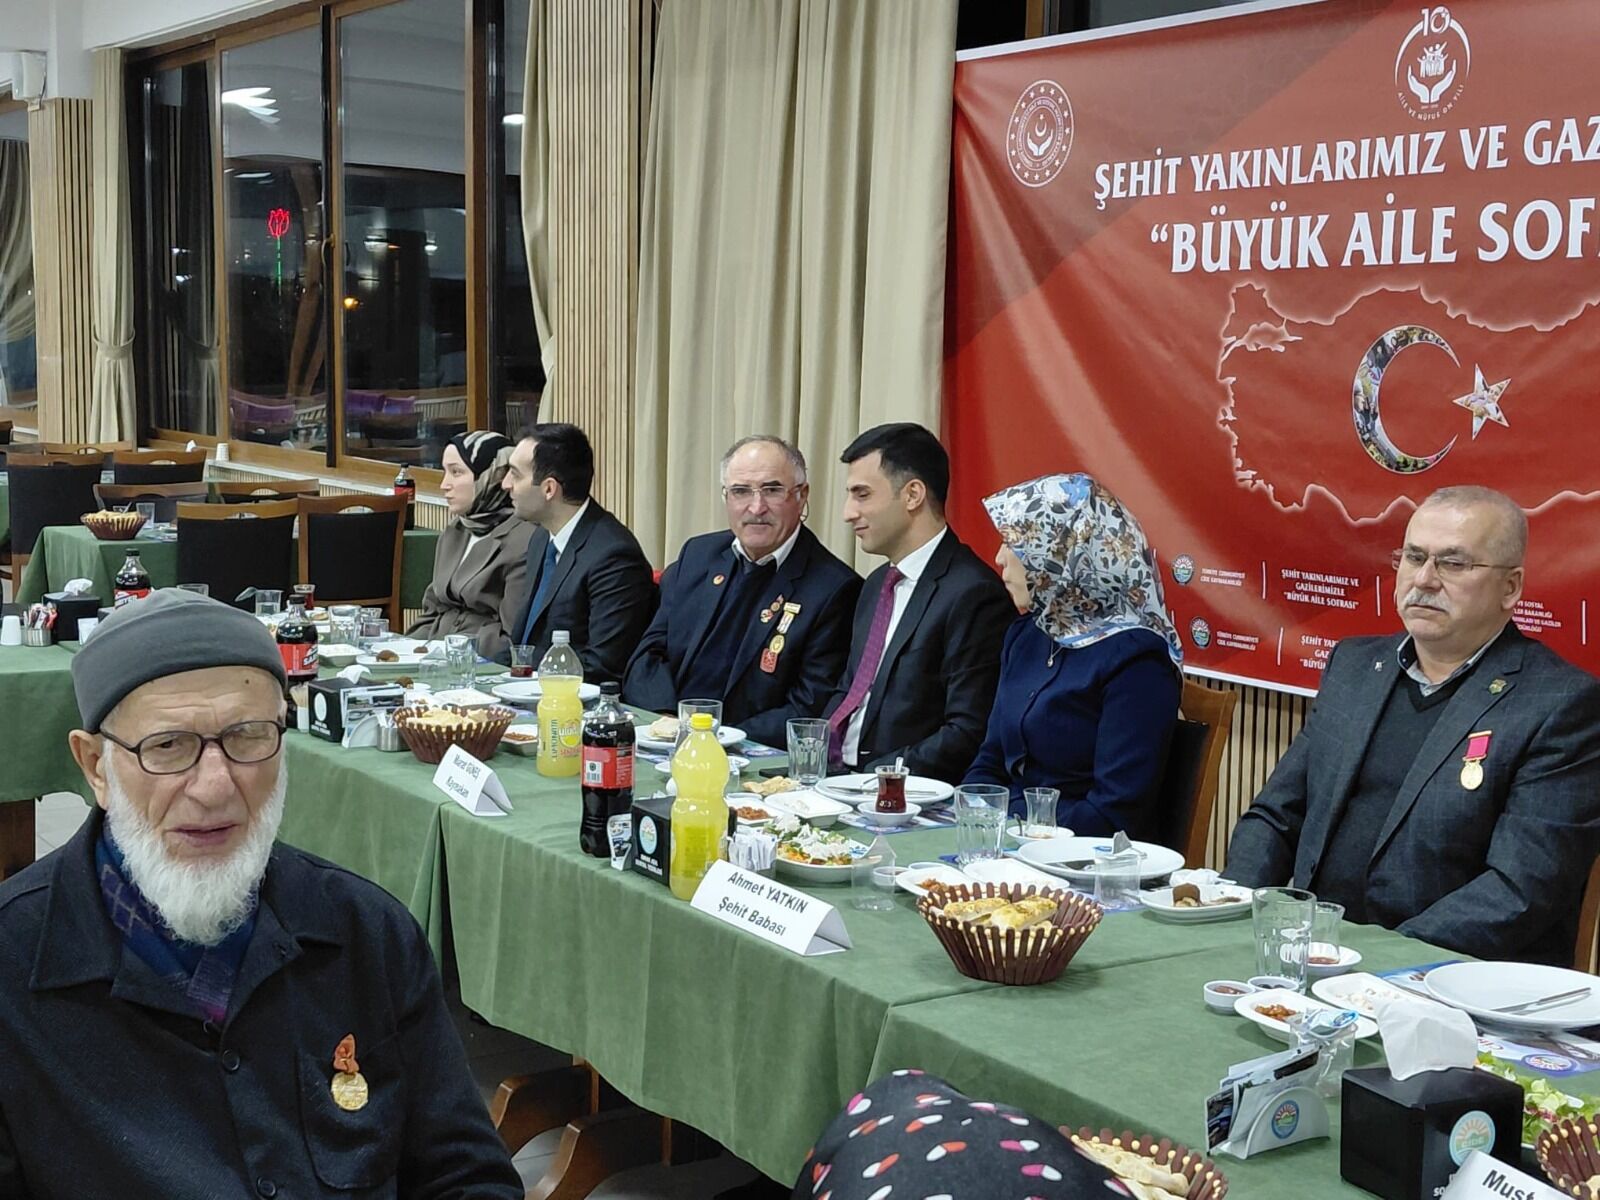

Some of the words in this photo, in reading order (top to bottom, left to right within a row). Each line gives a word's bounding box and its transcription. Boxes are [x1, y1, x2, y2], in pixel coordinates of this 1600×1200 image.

[1421, 6, 1451, 36] 10
[1094, 147, 1182, 210] ŞEHİT
[1190, 131, 1446, 192] YAKINLARIMIZ
[1459, 125, 1508, 170] VE
[1341, 193, 1457, 267] AİLE
[1478, 198, 1600, 262] SOF
[1281, 568, 1300, 579] ŞEHİT
[1301, 571, 1349, 586] YAKINLARIMIZ
[1350, 577, 1359, 587] VE
[1295, 581, 1346, 596] GAZİLERİMİZLE
[1310, 594, 1325, 605] AİLE
[1301, 634, 1322, 646] ŞEHİT
[727, 871, 765, 896] Ahmet
[766, 886, 809, 914] YATKIN
[718, 896, 749, 918] Şehit
[747, 909, 787, 936] Babası
